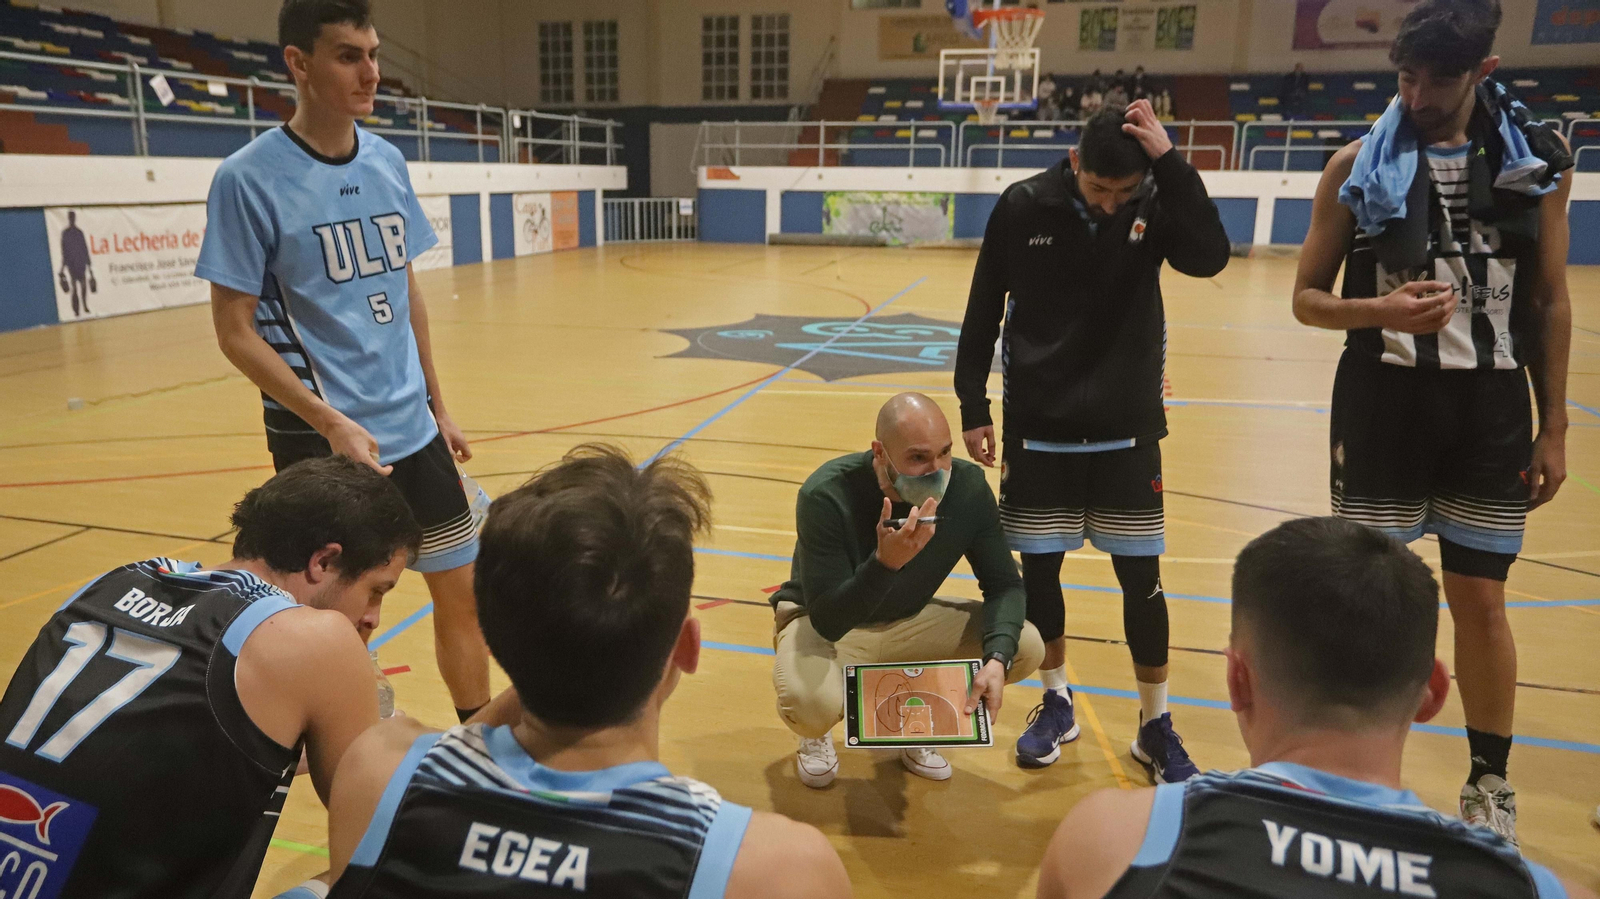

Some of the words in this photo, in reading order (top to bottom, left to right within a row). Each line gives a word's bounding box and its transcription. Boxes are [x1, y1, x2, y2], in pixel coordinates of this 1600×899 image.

[90, 235, 109, 255] La
[182, 228, 199, 248] de
[312, 212, 407, 284] ULB
[367, 292, 394, 325] 5
[114, 587, 196, 627] BORJA
[5, 620, 182, 763] 17
[458, 821, 589, 892] EGEA
[1262, 819, 1438, 898] YOME
